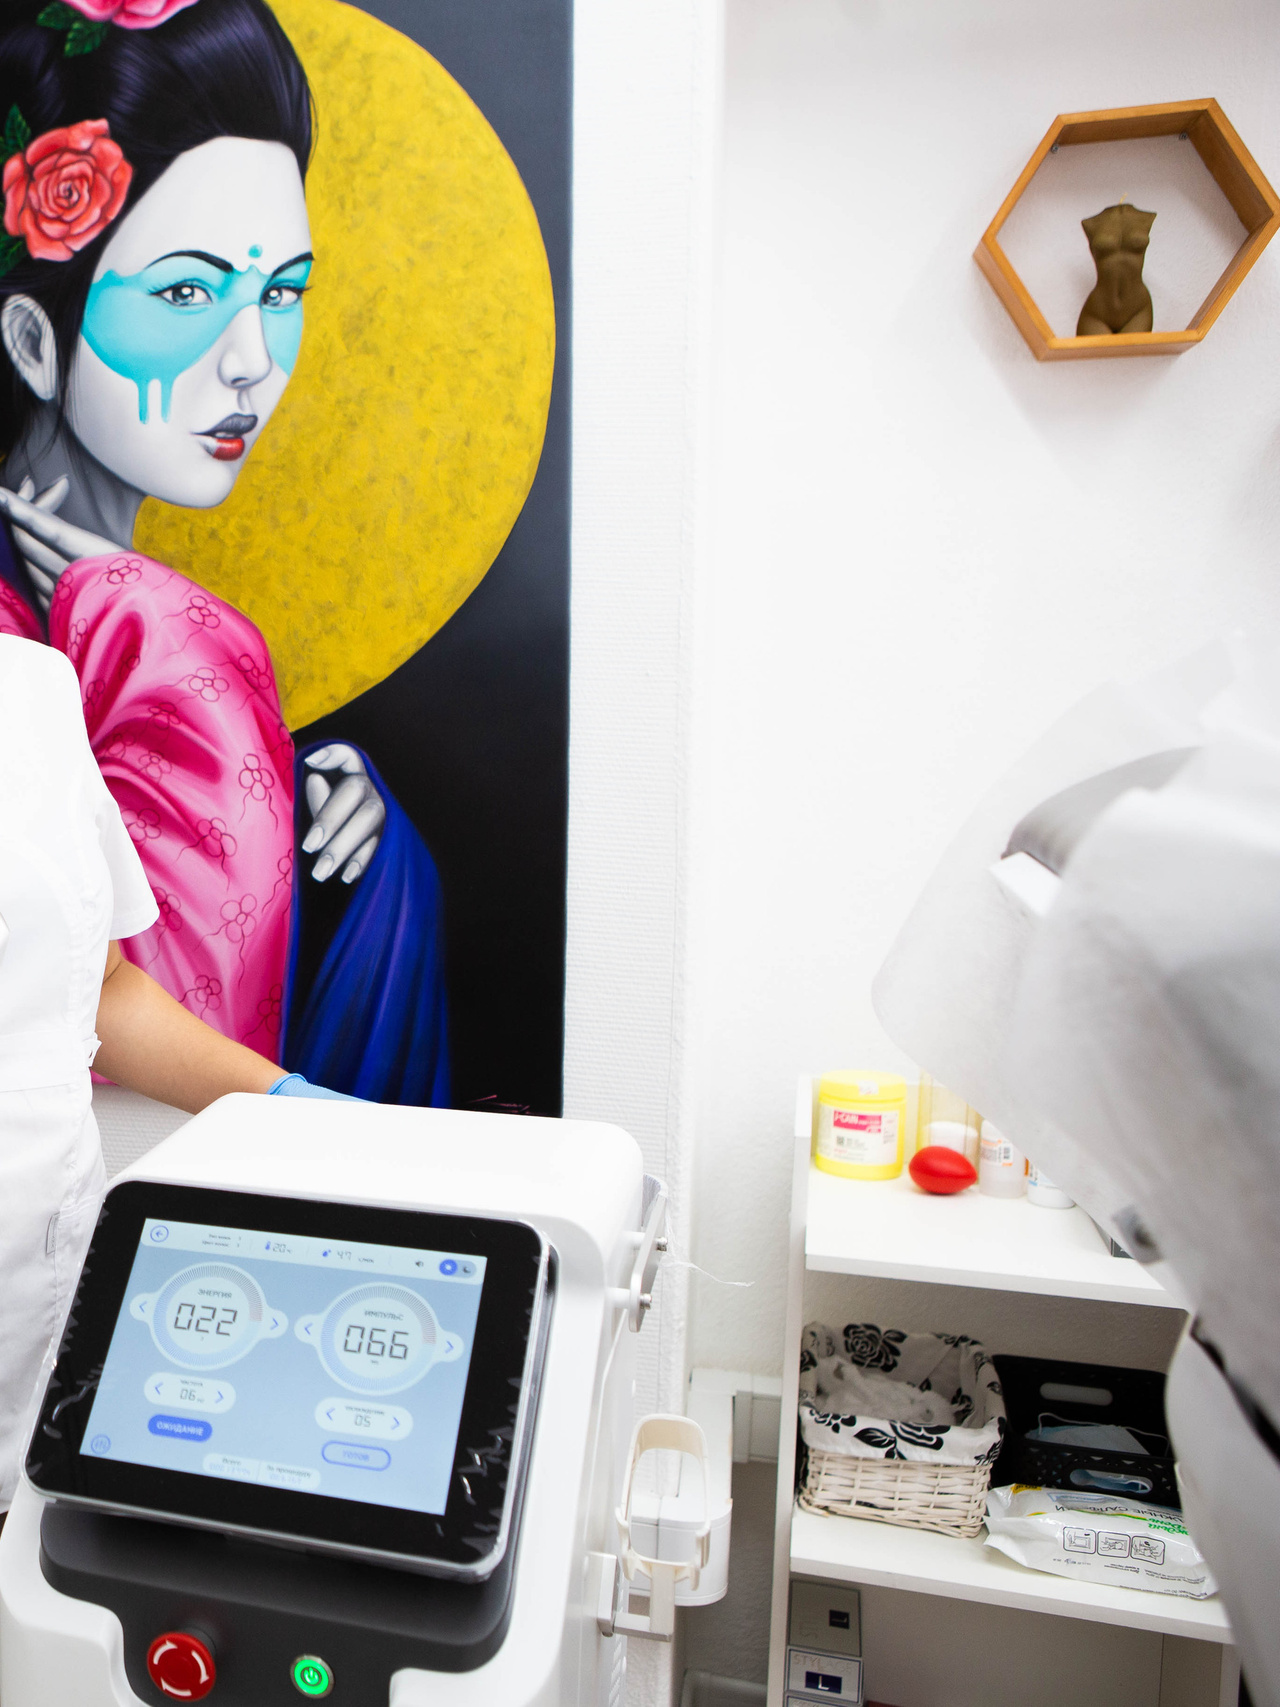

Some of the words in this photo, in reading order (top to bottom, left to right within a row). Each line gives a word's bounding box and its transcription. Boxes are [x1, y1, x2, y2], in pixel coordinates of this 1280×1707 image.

[198, 1288, 232, 1299] ЭНЕРГИЯ
[174, 1302, 238, 1336] 022
[364, 1310, 404, 1321] ИМПУЛЬС
[343, 1324, 409, 1360] 066
[180, 1388, 196, 1402] 06
[156, 1420, 204, 1436] ОЖИДАНИЕ
[354, 1414, 371, 1428] 05
[818, 1675, 830, 1690] L
